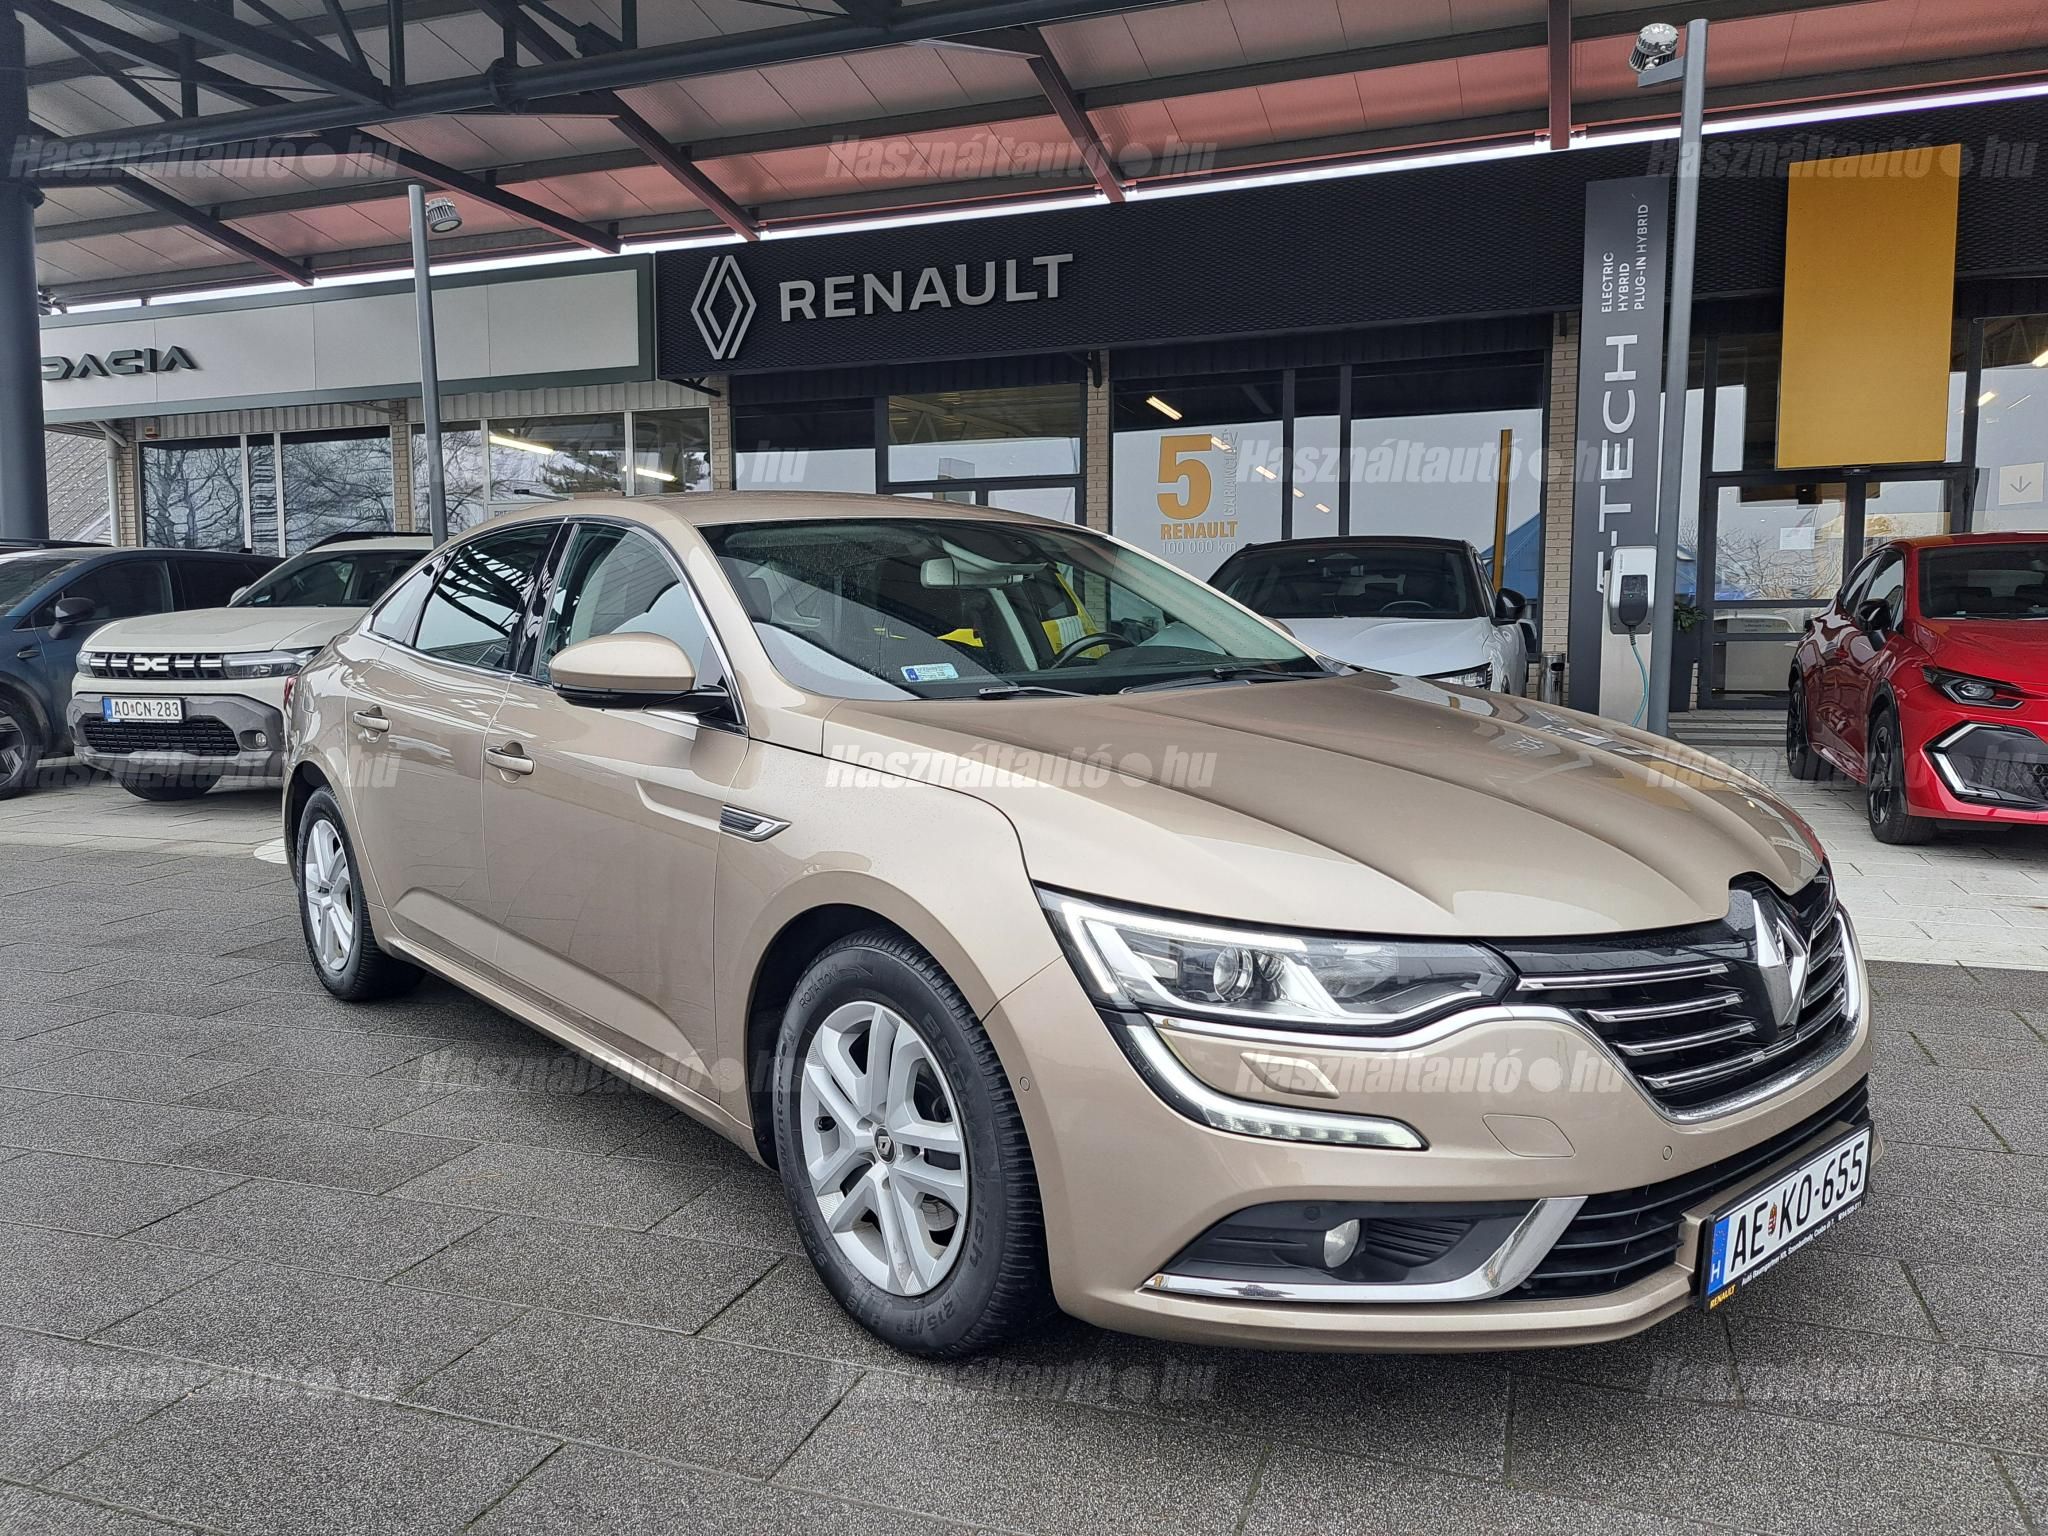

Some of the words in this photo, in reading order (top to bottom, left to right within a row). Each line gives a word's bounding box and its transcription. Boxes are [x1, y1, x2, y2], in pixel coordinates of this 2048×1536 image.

[1636, 204, 1649, 253] HYBRID
[779, 253, 1074, 322] RENAULT
[1601, 252, 1614, 313] ELECTRIC
[1618, 262, 1630, 312] HYBRID
[1634, 256, 1647, 310] PLUG-IN
[1157, 433, 1213, 520] 5
[1160, 521, 1238, 541] RENAULT
[1162, 541, 1185, 556] 100
[1187, 540, 1214, 554] 000
[1217, 540, 1238, 553] km
[1711, 1259, 1721, 1283] H
[1708, 1283, 1737, 1310] RENAULT
